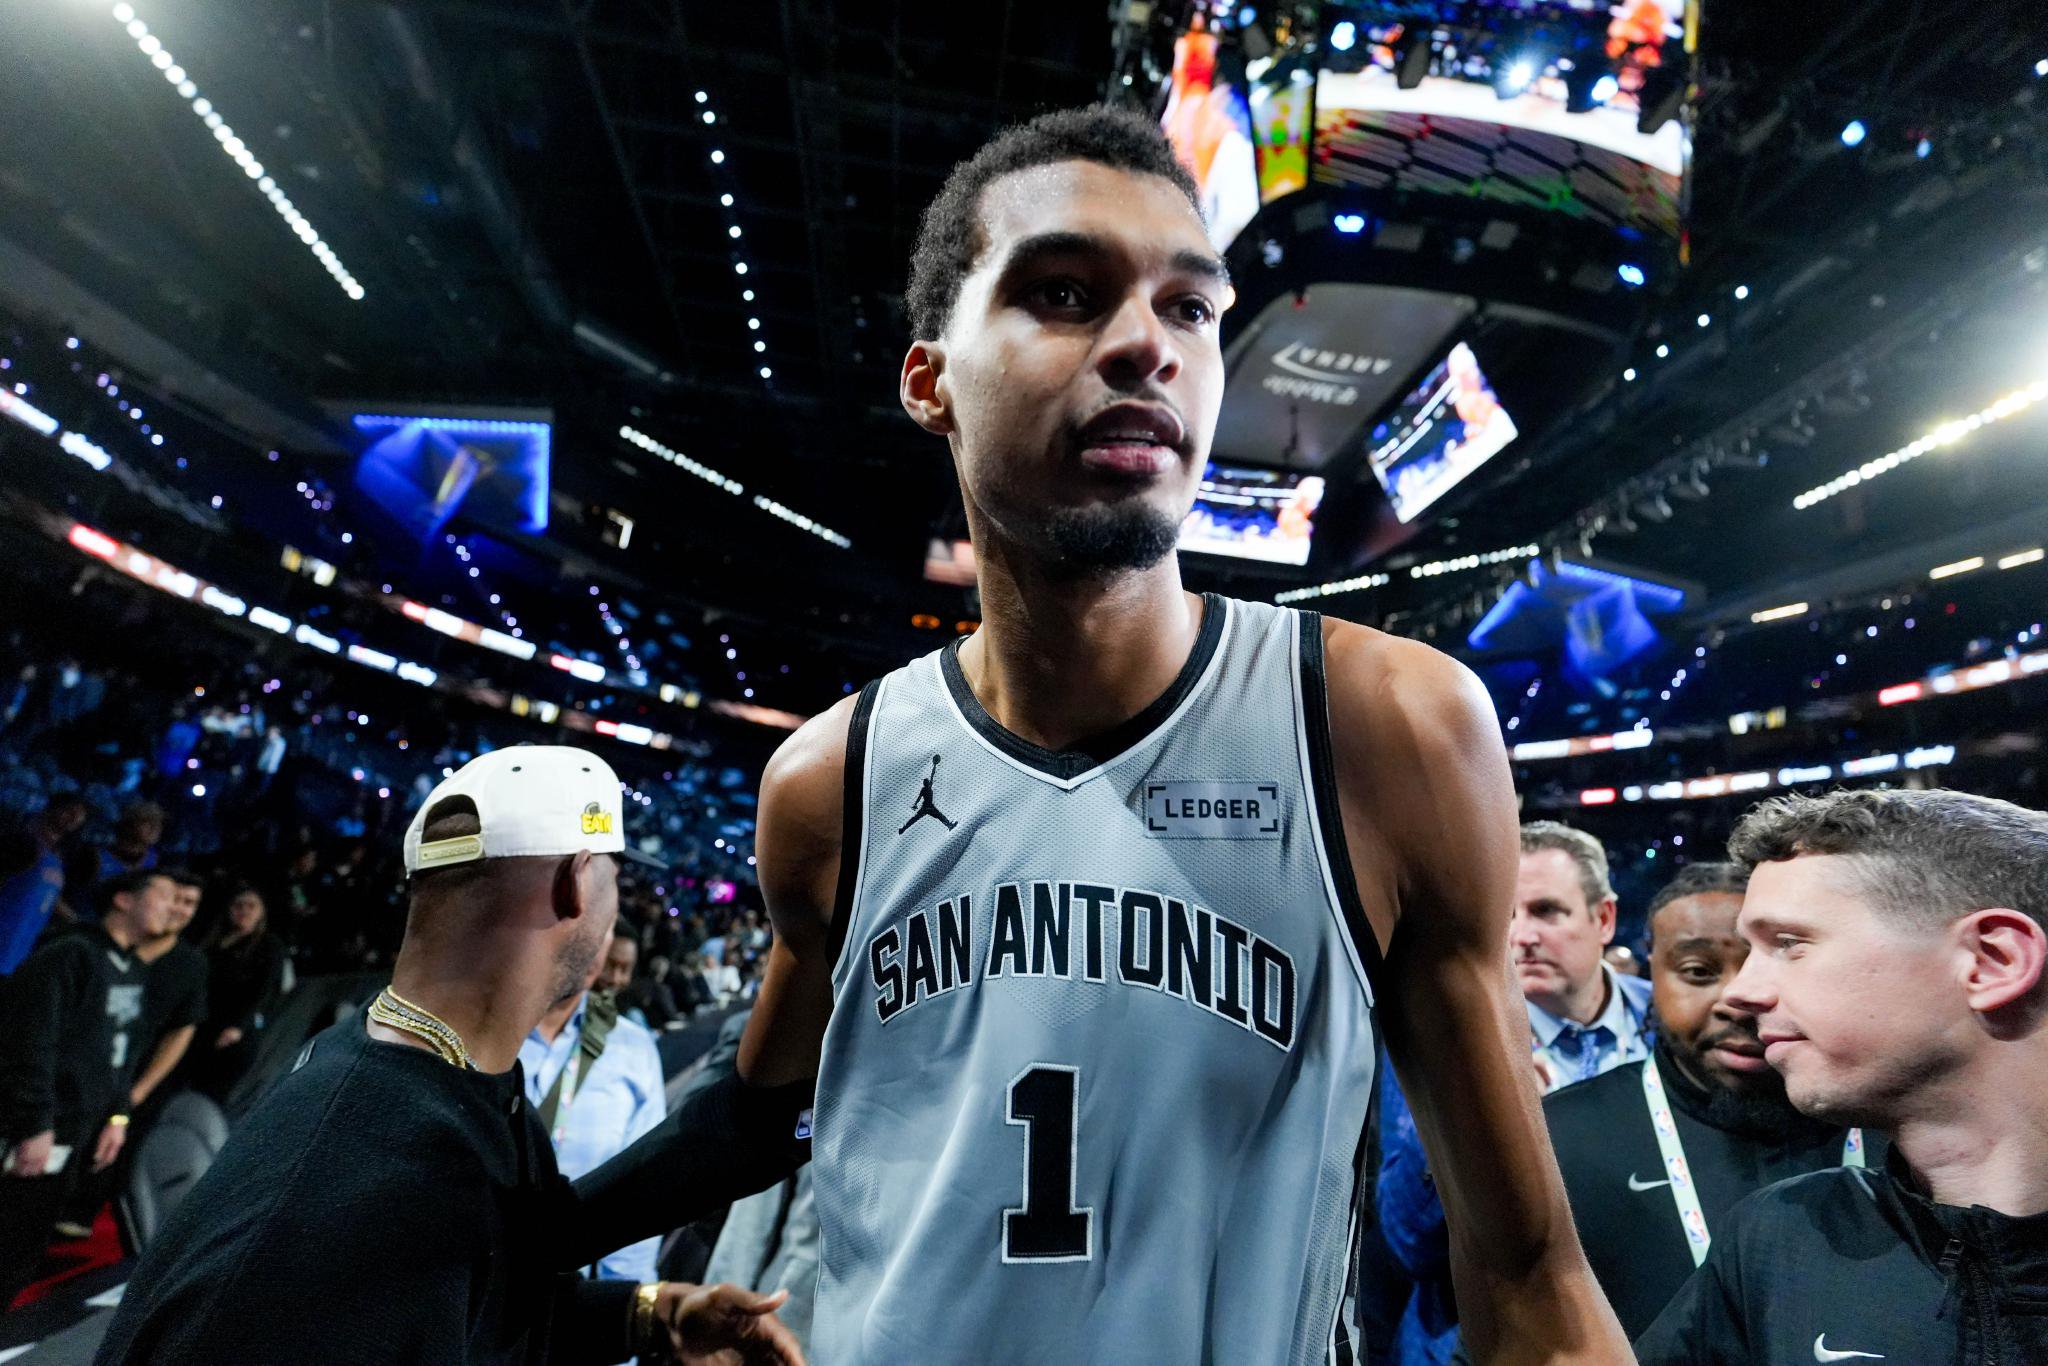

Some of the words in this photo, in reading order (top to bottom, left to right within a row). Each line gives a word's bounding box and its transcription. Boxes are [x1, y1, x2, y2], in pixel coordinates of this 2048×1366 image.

[1164, 798, 1261, 819] LEDGER
[869, 891, 973, 1025] SAN
[985, 879, 1298, 1053] ANTONIO
[1002, 1062, 1093, 1264] 1
